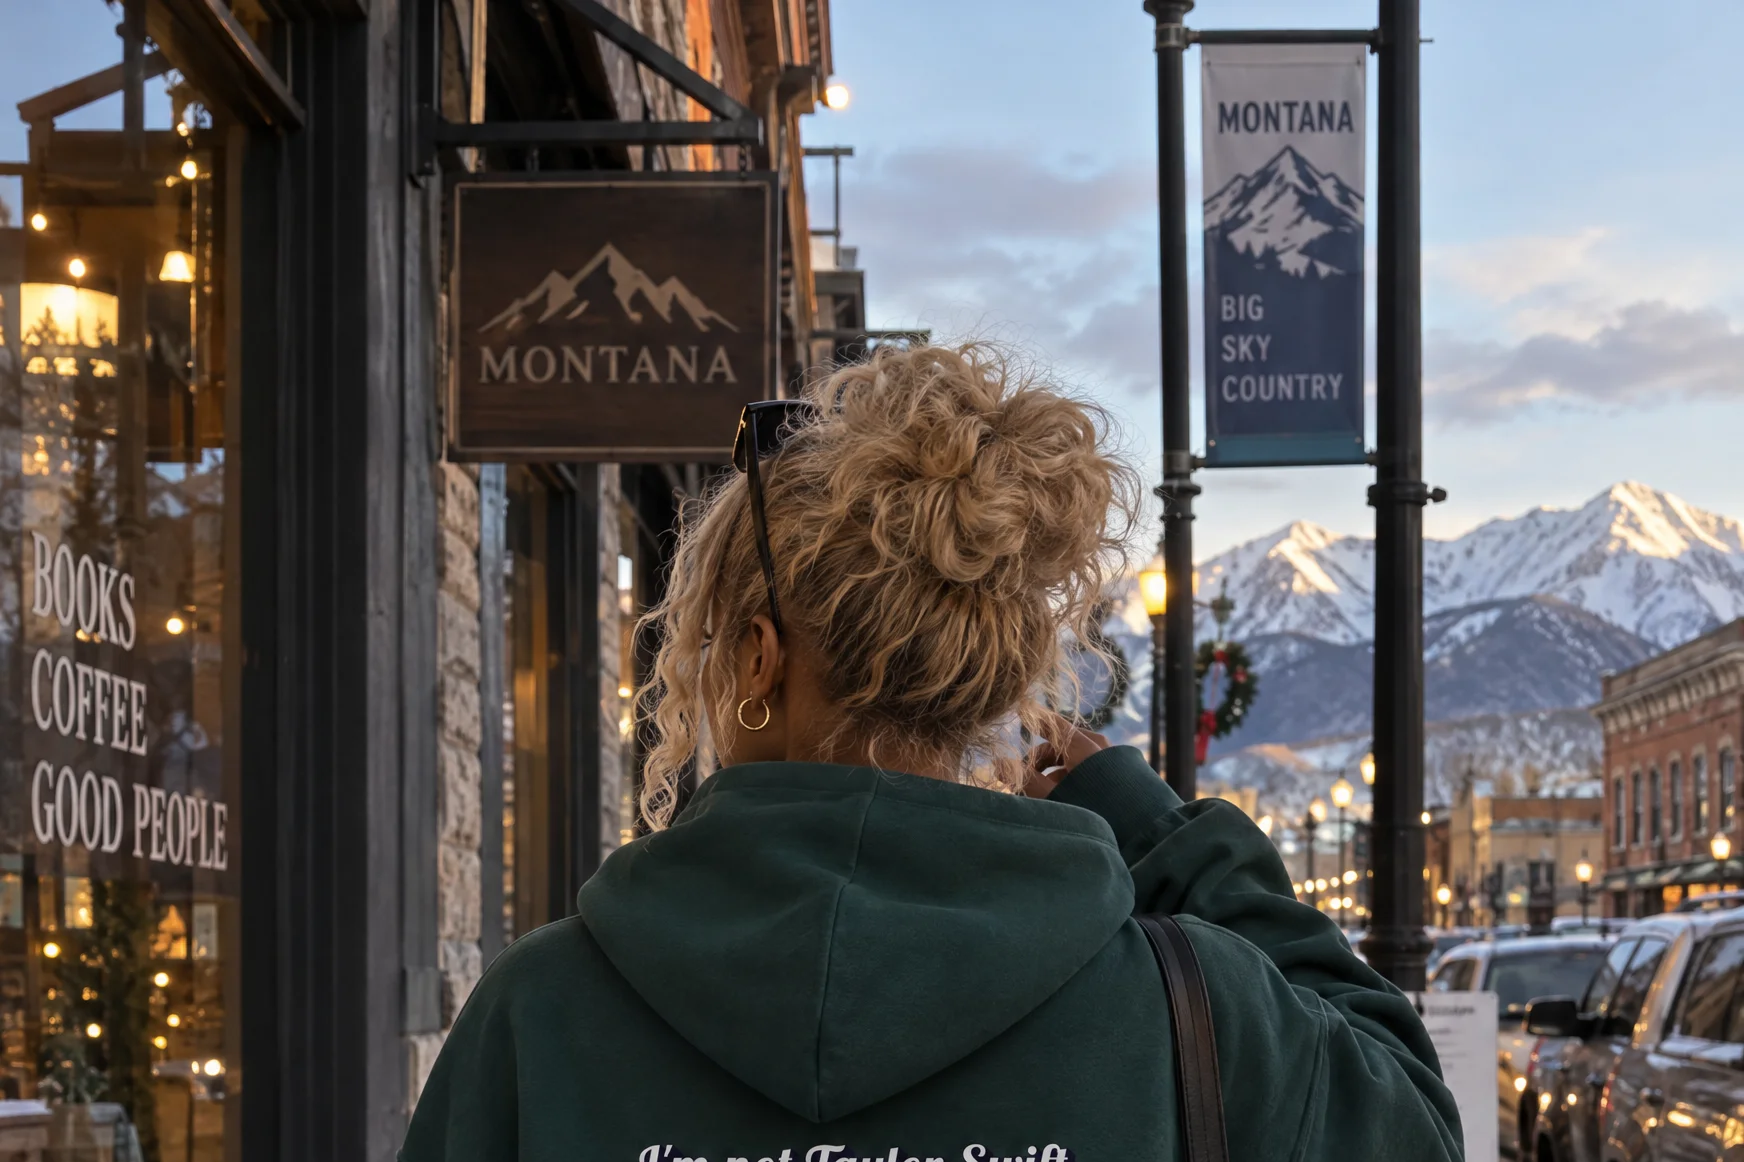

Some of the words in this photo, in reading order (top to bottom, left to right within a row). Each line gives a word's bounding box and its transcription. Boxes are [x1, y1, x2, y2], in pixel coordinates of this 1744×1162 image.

[1218, 100, 1355, 134] MONTANA
[1221, 295, 1264, 322] BIG
[478, 346, 738, 383] MONTANA
[1221, 334, 1271, 362] SKY
[1222, 373, 1343, 402] COUNTRY
[31, 530, 136, 651] BOOKS
[31, 648, 148, 756] COFFEE
[31, 760, 123, 853] GOOD
[132, 783, 228, 870] PEOPLE
